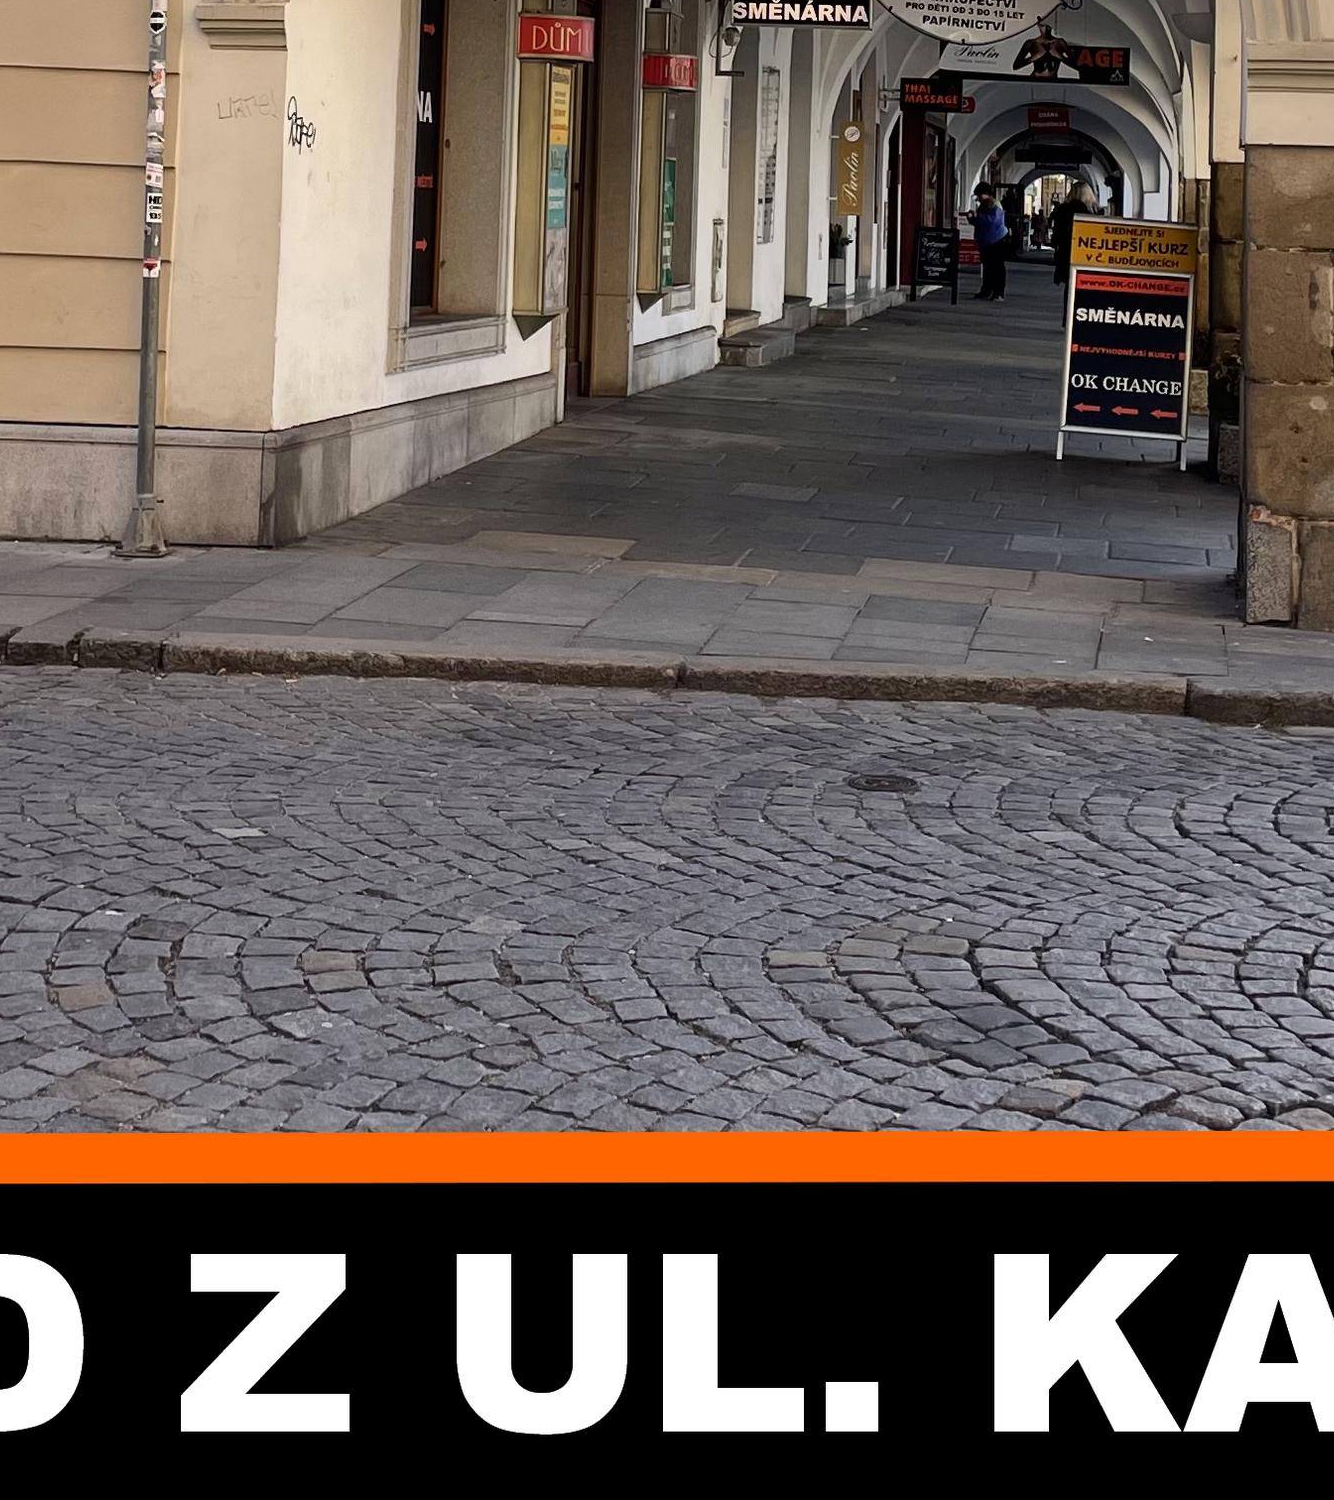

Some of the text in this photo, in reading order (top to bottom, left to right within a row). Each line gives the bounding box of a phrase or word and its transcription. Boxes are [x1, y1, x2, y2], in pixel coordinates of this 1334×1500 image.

[905, 1, 1026, 20] PRO DĚTI OD 3 DO 15 LET
[922, 14, 1006, 32] PAPÍRNICTVÍ
[532, 21, 583, 53] DŮM
[904, 94, 958, 105] MASSAGE
[1104, 225, 1165, 238] SJEDNEJTE SI
[1078, 235, 1189, 256] NEJLEPŠÍ KURZ
[1075, 306, 1185, 329] SMĚNÁRNA
[1071, 373, 1182, 396] OK CHANGE
